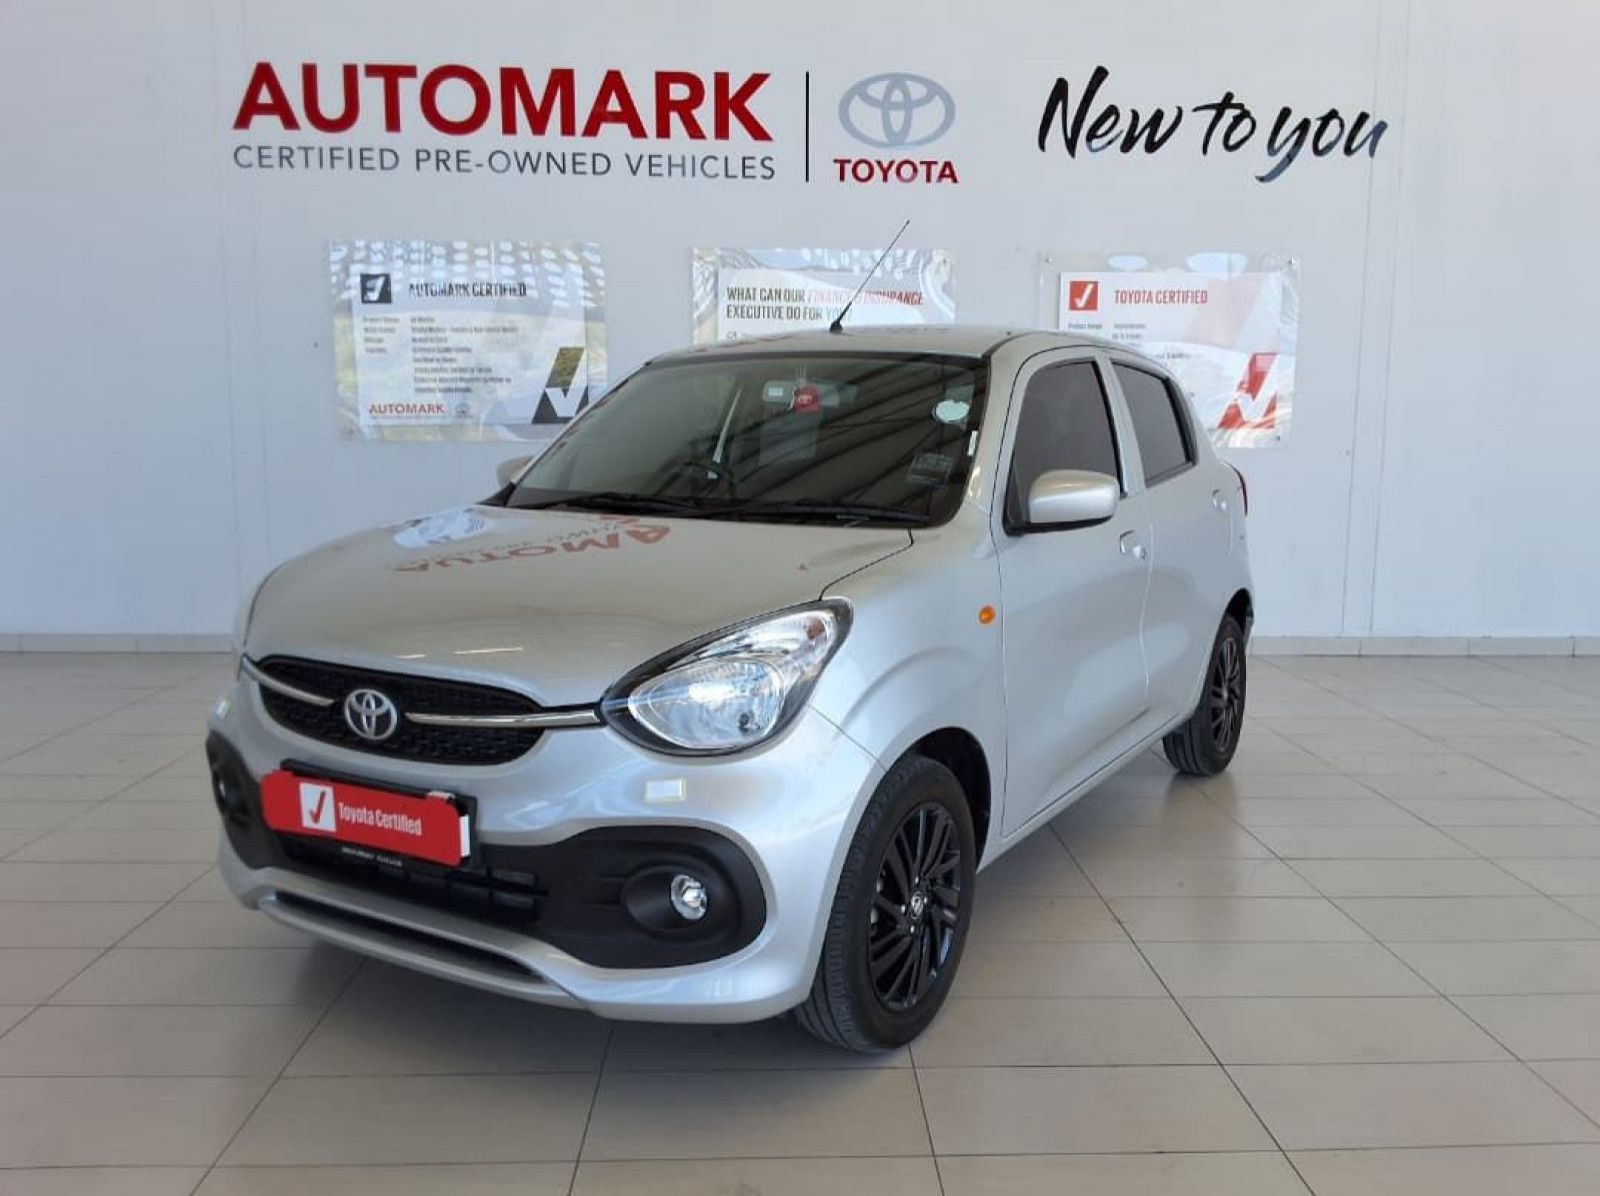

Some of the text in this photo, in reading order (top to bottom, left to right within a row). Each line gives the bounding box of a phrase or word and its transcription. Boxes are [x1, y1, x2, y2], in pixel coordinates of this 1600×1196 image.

[232, 61, 773, 141] AUTOMARK
[1038, 65, 1388, 184] New to you
[233, 144, 776, 180] CERTIFIED PRE-OWNED VEHICLES
[832, 158, 959, 185] TOYOTA
[471, 282, 528, 298] CERTIFIED
[727, 286, 757, 302] WHAT
[760, 288, 782, 303] CAN
[783, 288, 806, 304] OUR
[1114, 289, 1209, 305] TOYOTA CERTIFIED
[726, 303, 784, 319] EXECUTIVE
[786, 305, 802, 321] DO
[803, 306, 823, 322] FOR
[368, 403, 446, 416] AUTOMARK
[338, 802, 423, 837] Toyota Certified
